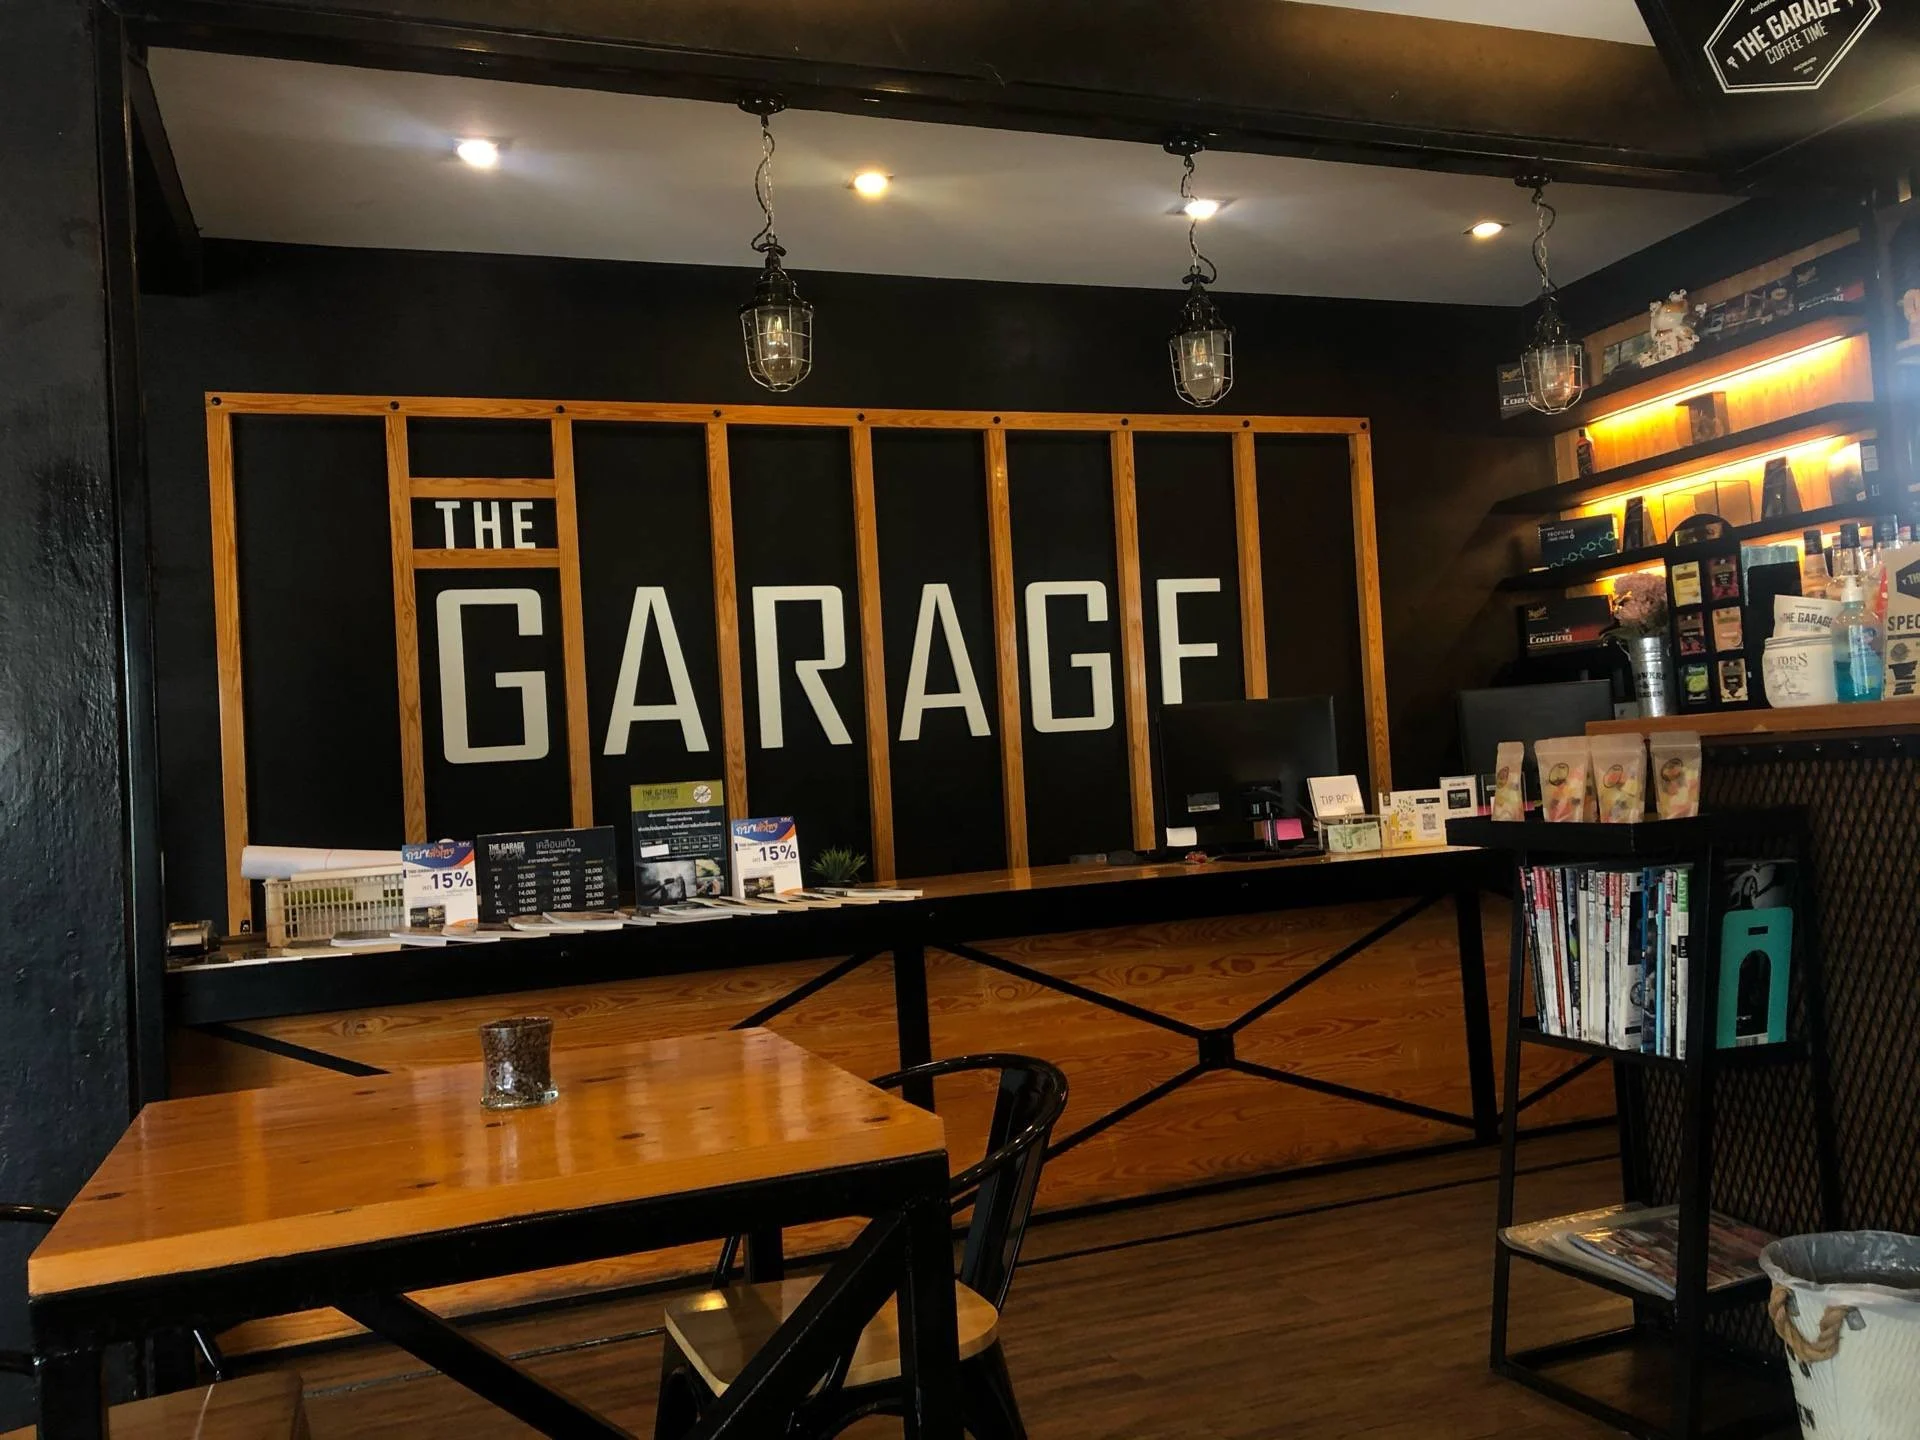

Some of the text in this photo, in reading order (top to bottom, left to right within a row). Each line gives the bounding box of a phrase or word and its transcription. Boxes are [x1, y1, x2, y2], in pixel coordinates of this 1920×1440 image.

[1733, 0, 1841, 62] THE GARAGE
[1765, 34, 1804, 64] COFFEE
[1801, 20, 1828, 44] TIME
[435, 501, 536, 549] THE
[1320, 795, 1334, 804] TIP
[759, 845, 797, 861] 15%
[431, 871, 473, 889] 15%
